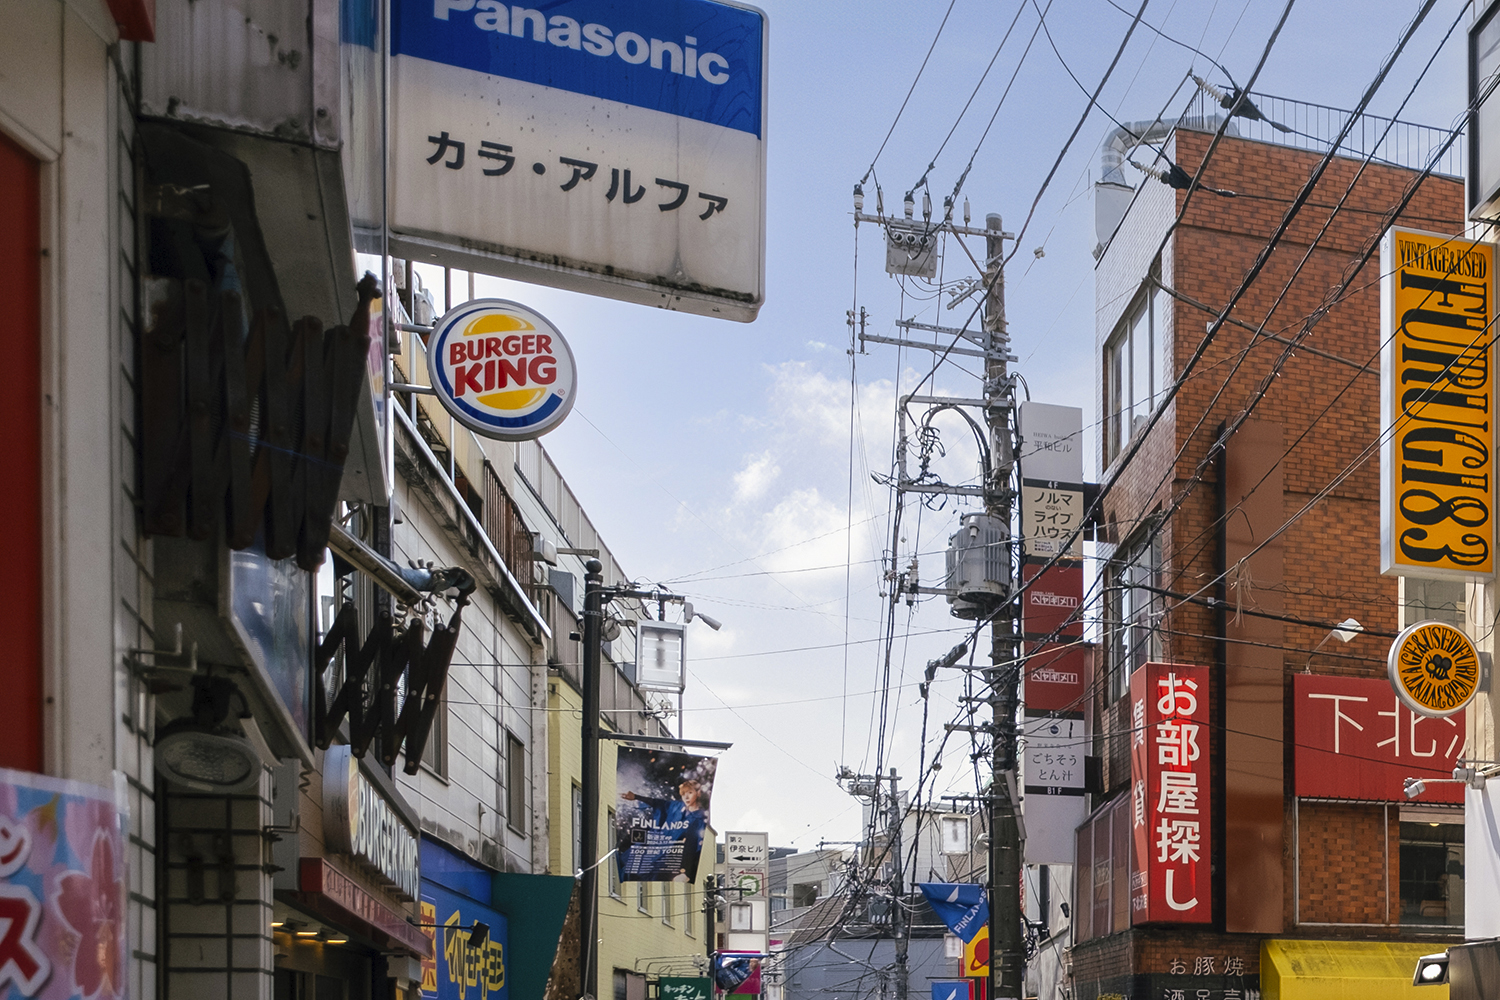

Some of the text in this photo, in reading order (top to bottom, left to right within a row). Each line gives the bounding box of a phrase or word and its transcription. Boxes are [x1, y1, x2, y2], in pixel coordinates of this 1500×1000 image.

[426, 131, 728, 221] カラ・アルファ
[450, 335, 553, 366] BURGER
[455, 355, 557, 398] KING
[1399, 269, 1489, 566] FURUGI83
[1034, 491, 1073, 506] ノルマ
[1034, 511, 1073, 525] ライブ
[1034, 525, 1073, 540] ハウス
[1032, 753, 1077, 766] ごちそう
[1039, 769, 1074, 781] とん汁
[1156, 672, 1201, 912] お部屋探し
[632, 818, 690, 831] FINLANDS
[953, 890, 987, 934] FINLANDS
